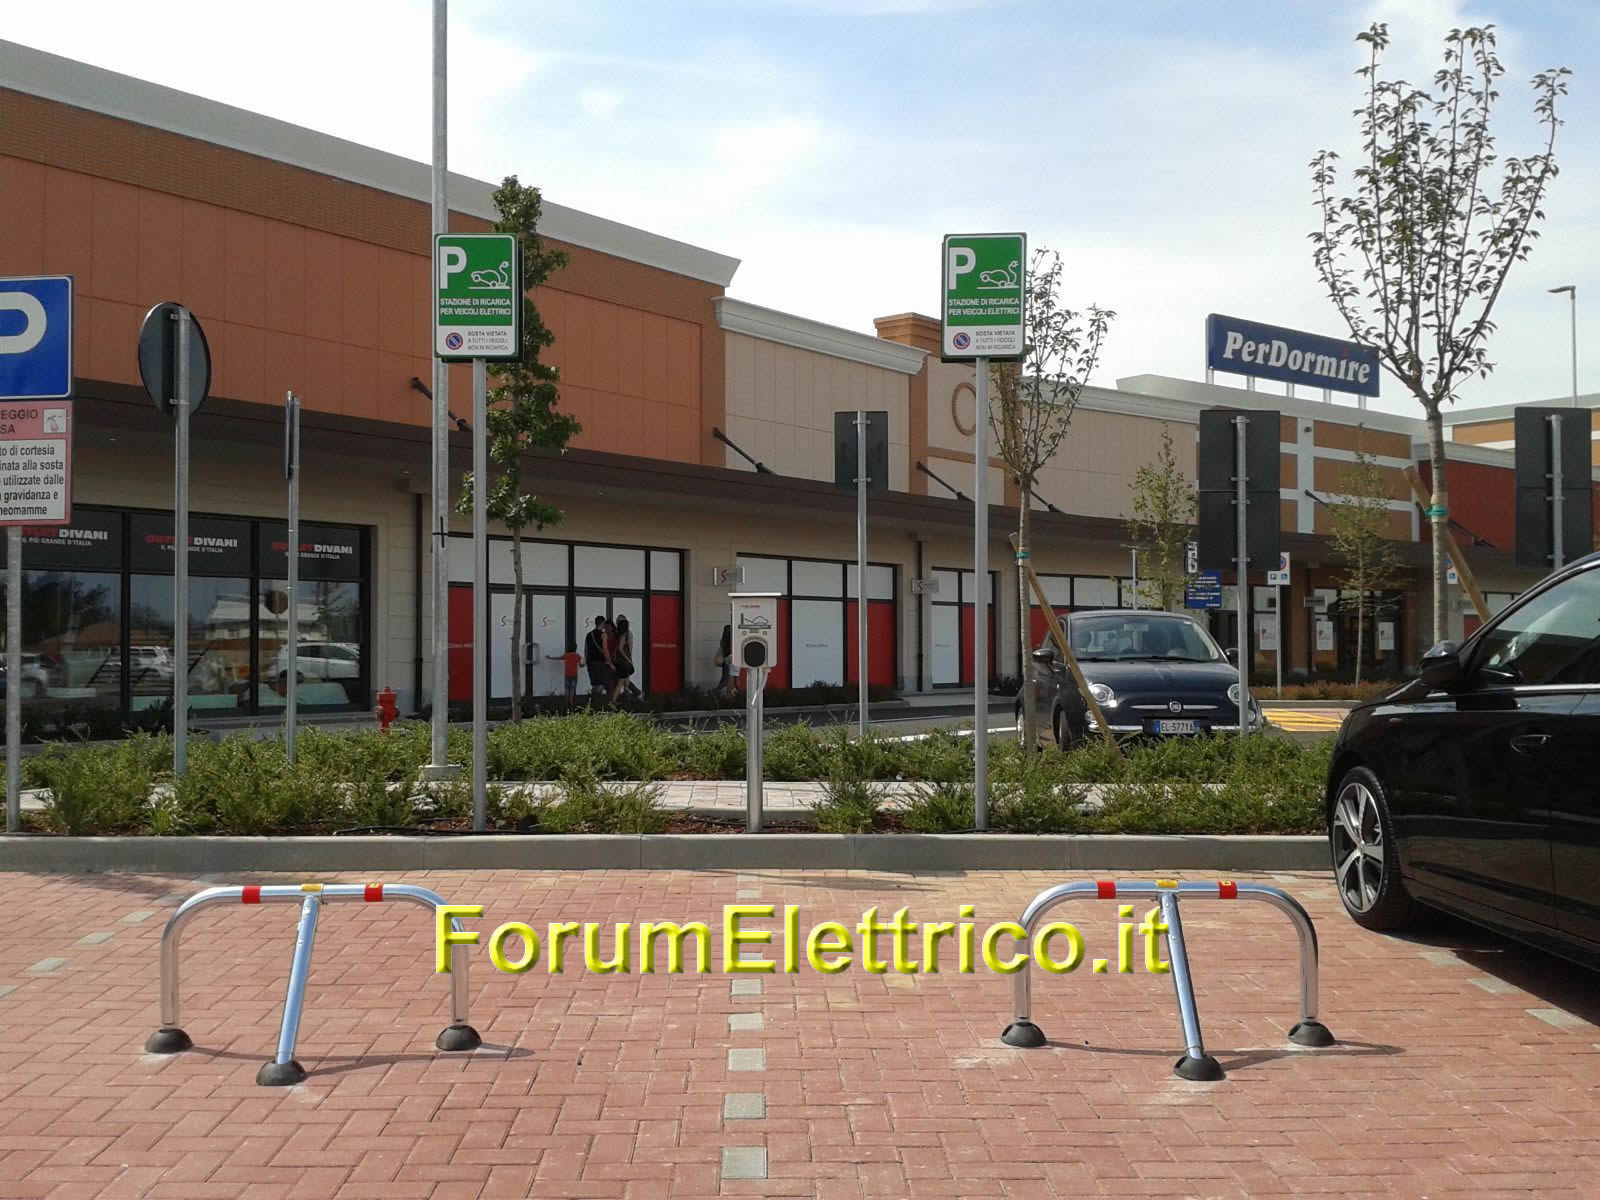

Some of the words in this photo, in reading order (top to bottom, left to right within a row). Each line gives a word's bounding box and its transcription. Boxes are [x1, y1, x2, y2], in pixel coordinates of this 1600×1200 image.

[440, 246, 467, 289] P
[949, 247, 976, 290] P
[440, 298, 471, 306] STAZIONE
[473, 298, 479, 306] DI
[480, 298, 511, 306] RICARICA
[949, 298, 980, 306] STAZIONE
[981, 298, 988, 306] DI
[480, 308, 511, 316] ELETTRICI
[949, 308, 962, 316] PER
[988, 307, 1019, 315] ELETTRICI
[1223, 331, 1370, 383] PerDormire
[10, 445, 17, 456] di
[20, 444, 55, 456] cortesia
[22, 459, 37, 470] alla
[40, 459, 64, 470] sosta
[3, 474, 41, 486] utilizzate
[43, 474, 64, 485] dalle
[4, 489, 51, 503] gravidanza
[53, 491, 58, 500] e
[59, 528, 108, 540] DIVANI
[194, 537, 238, 547] DIVANI
[314, 544, 353, 554] DIVANI
